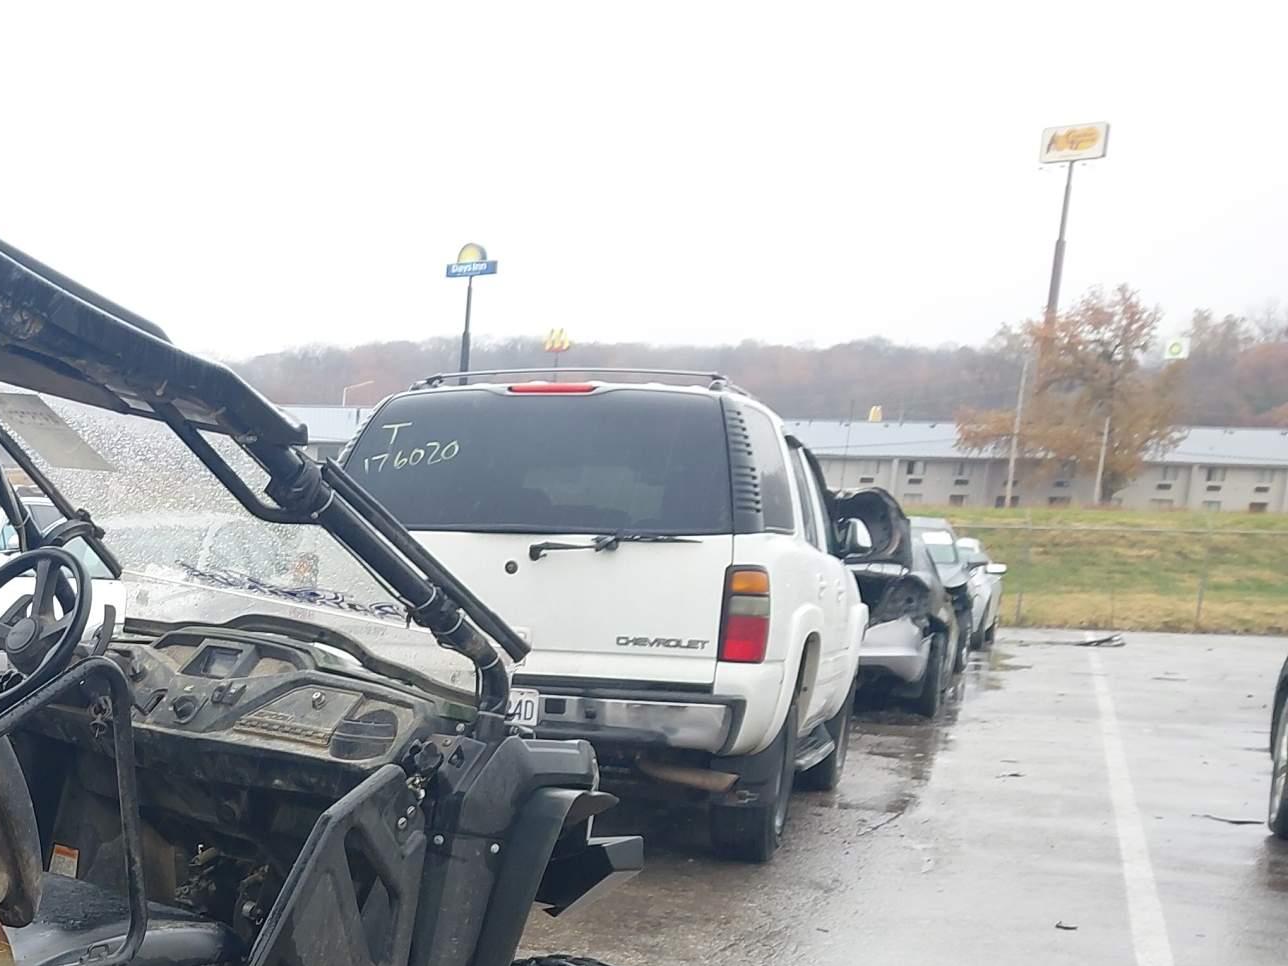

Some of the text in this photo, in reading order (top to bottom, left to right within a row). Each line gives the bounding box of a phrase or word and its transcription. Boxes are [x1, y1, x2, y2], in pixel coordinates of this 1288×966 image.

[381, 422, 413, 445] T
[364, 440, 460, 475] 176020
[615, 636, 710, 650] CHEVROLET
